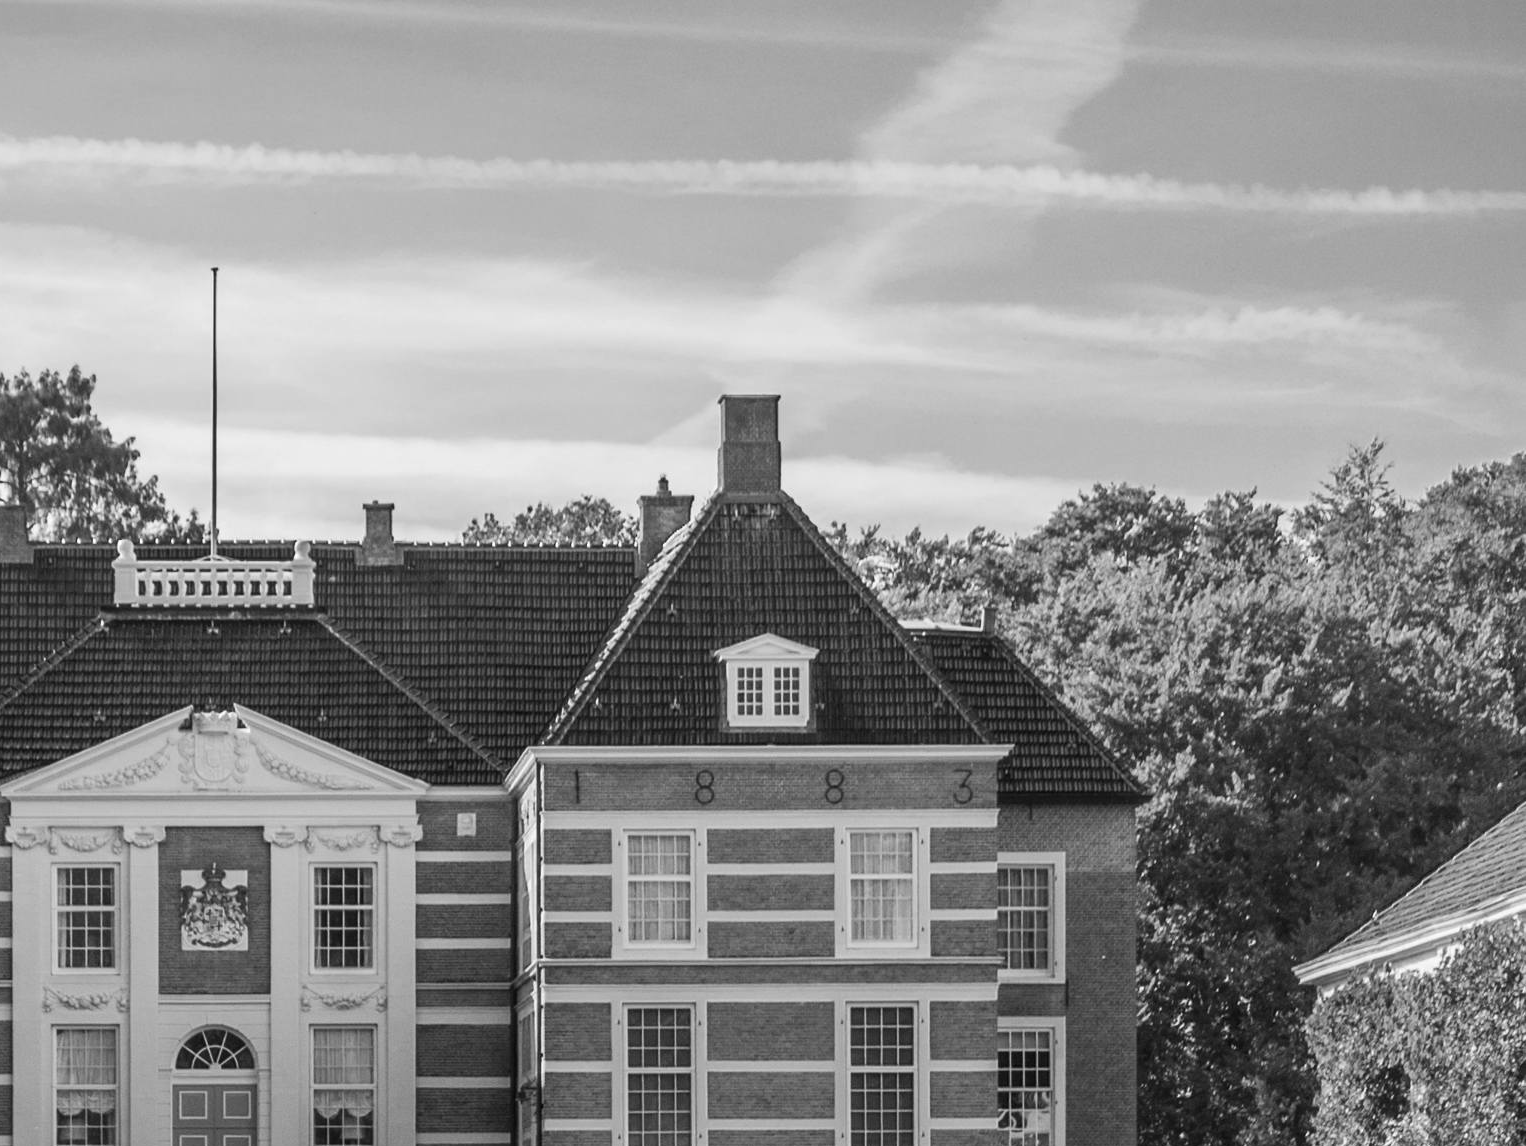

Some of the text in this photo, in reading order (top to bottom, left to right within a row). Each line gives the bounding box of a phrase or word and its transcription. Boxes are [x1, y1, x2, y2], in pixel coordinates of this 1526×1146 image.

[694, 769, 715, 805] 8
[825, 769, 845, 804] 8
[952, 769, 974, 805] 3
